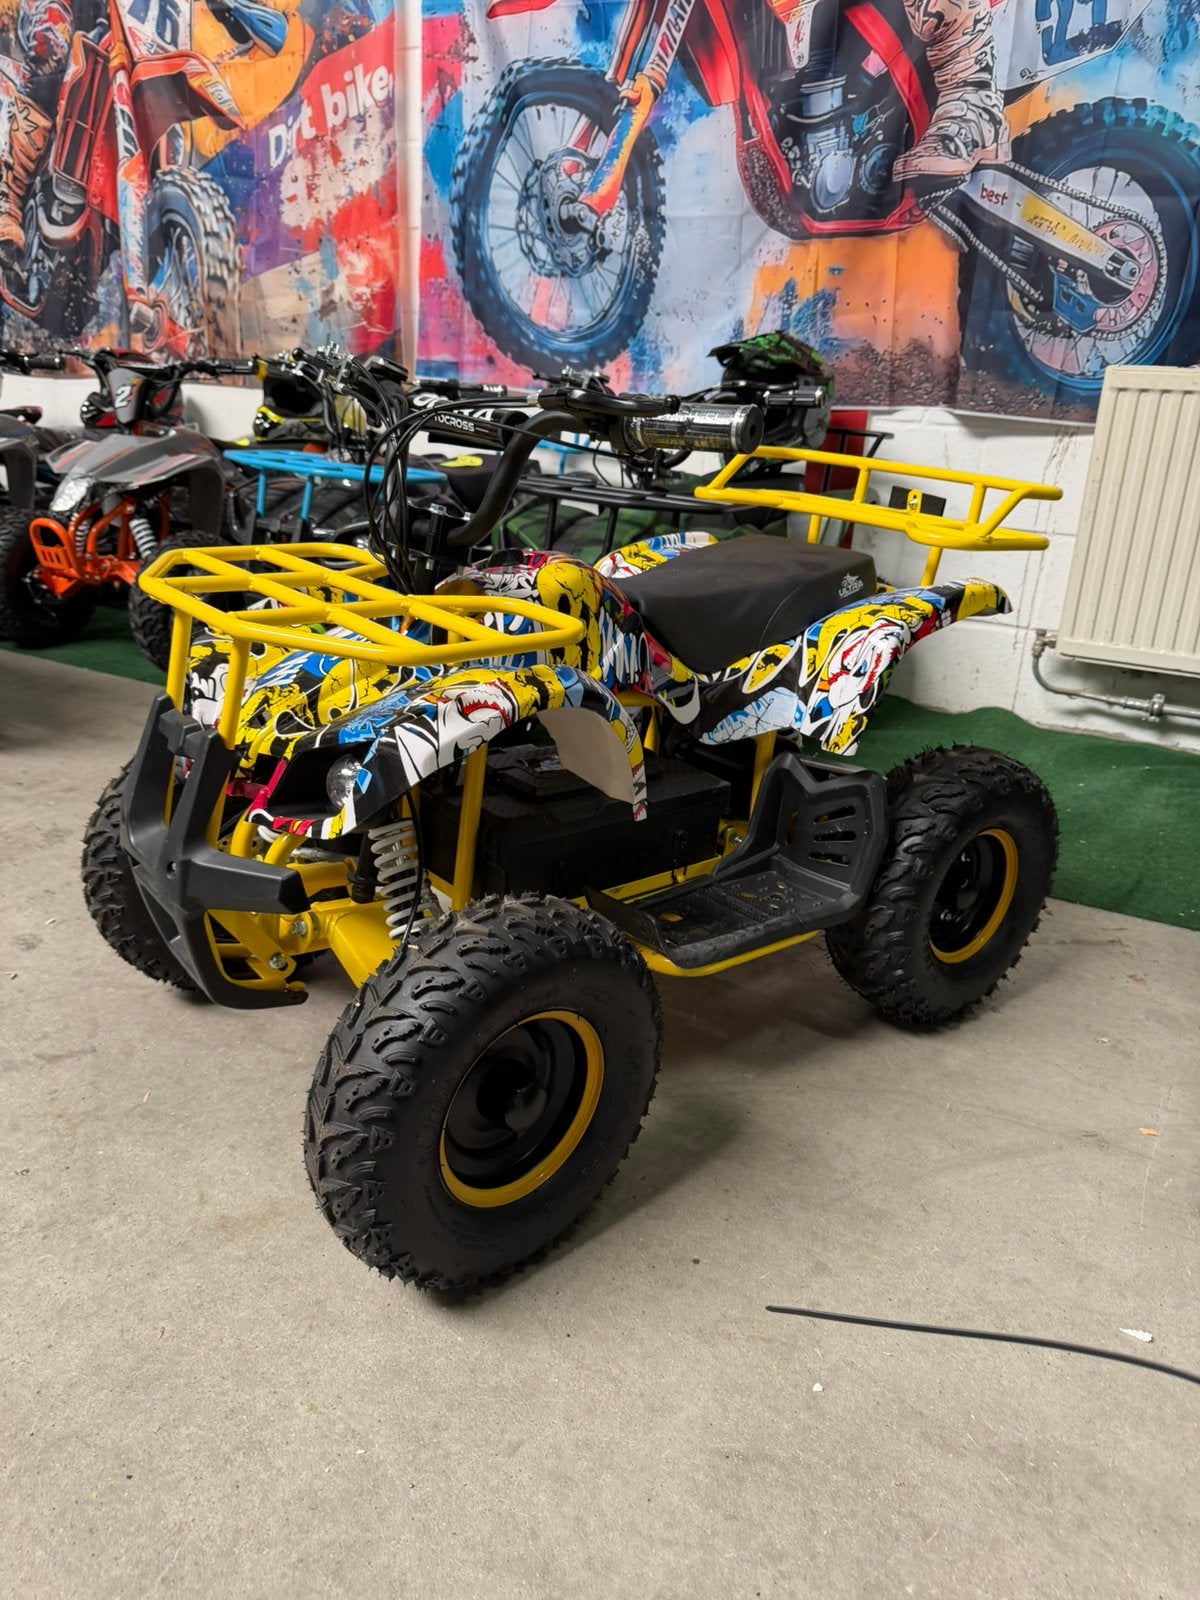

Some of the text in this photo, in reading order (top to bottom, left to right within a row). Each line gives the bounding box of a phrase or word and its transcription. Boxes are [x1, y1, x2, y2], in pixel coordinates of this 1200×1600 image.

[268, 63, 394, 171] Dirt bike
[980, 183, 1009, 206] best
[114, 385, 132, 408] 2
[838, 579, 864, 597] ULTRA
